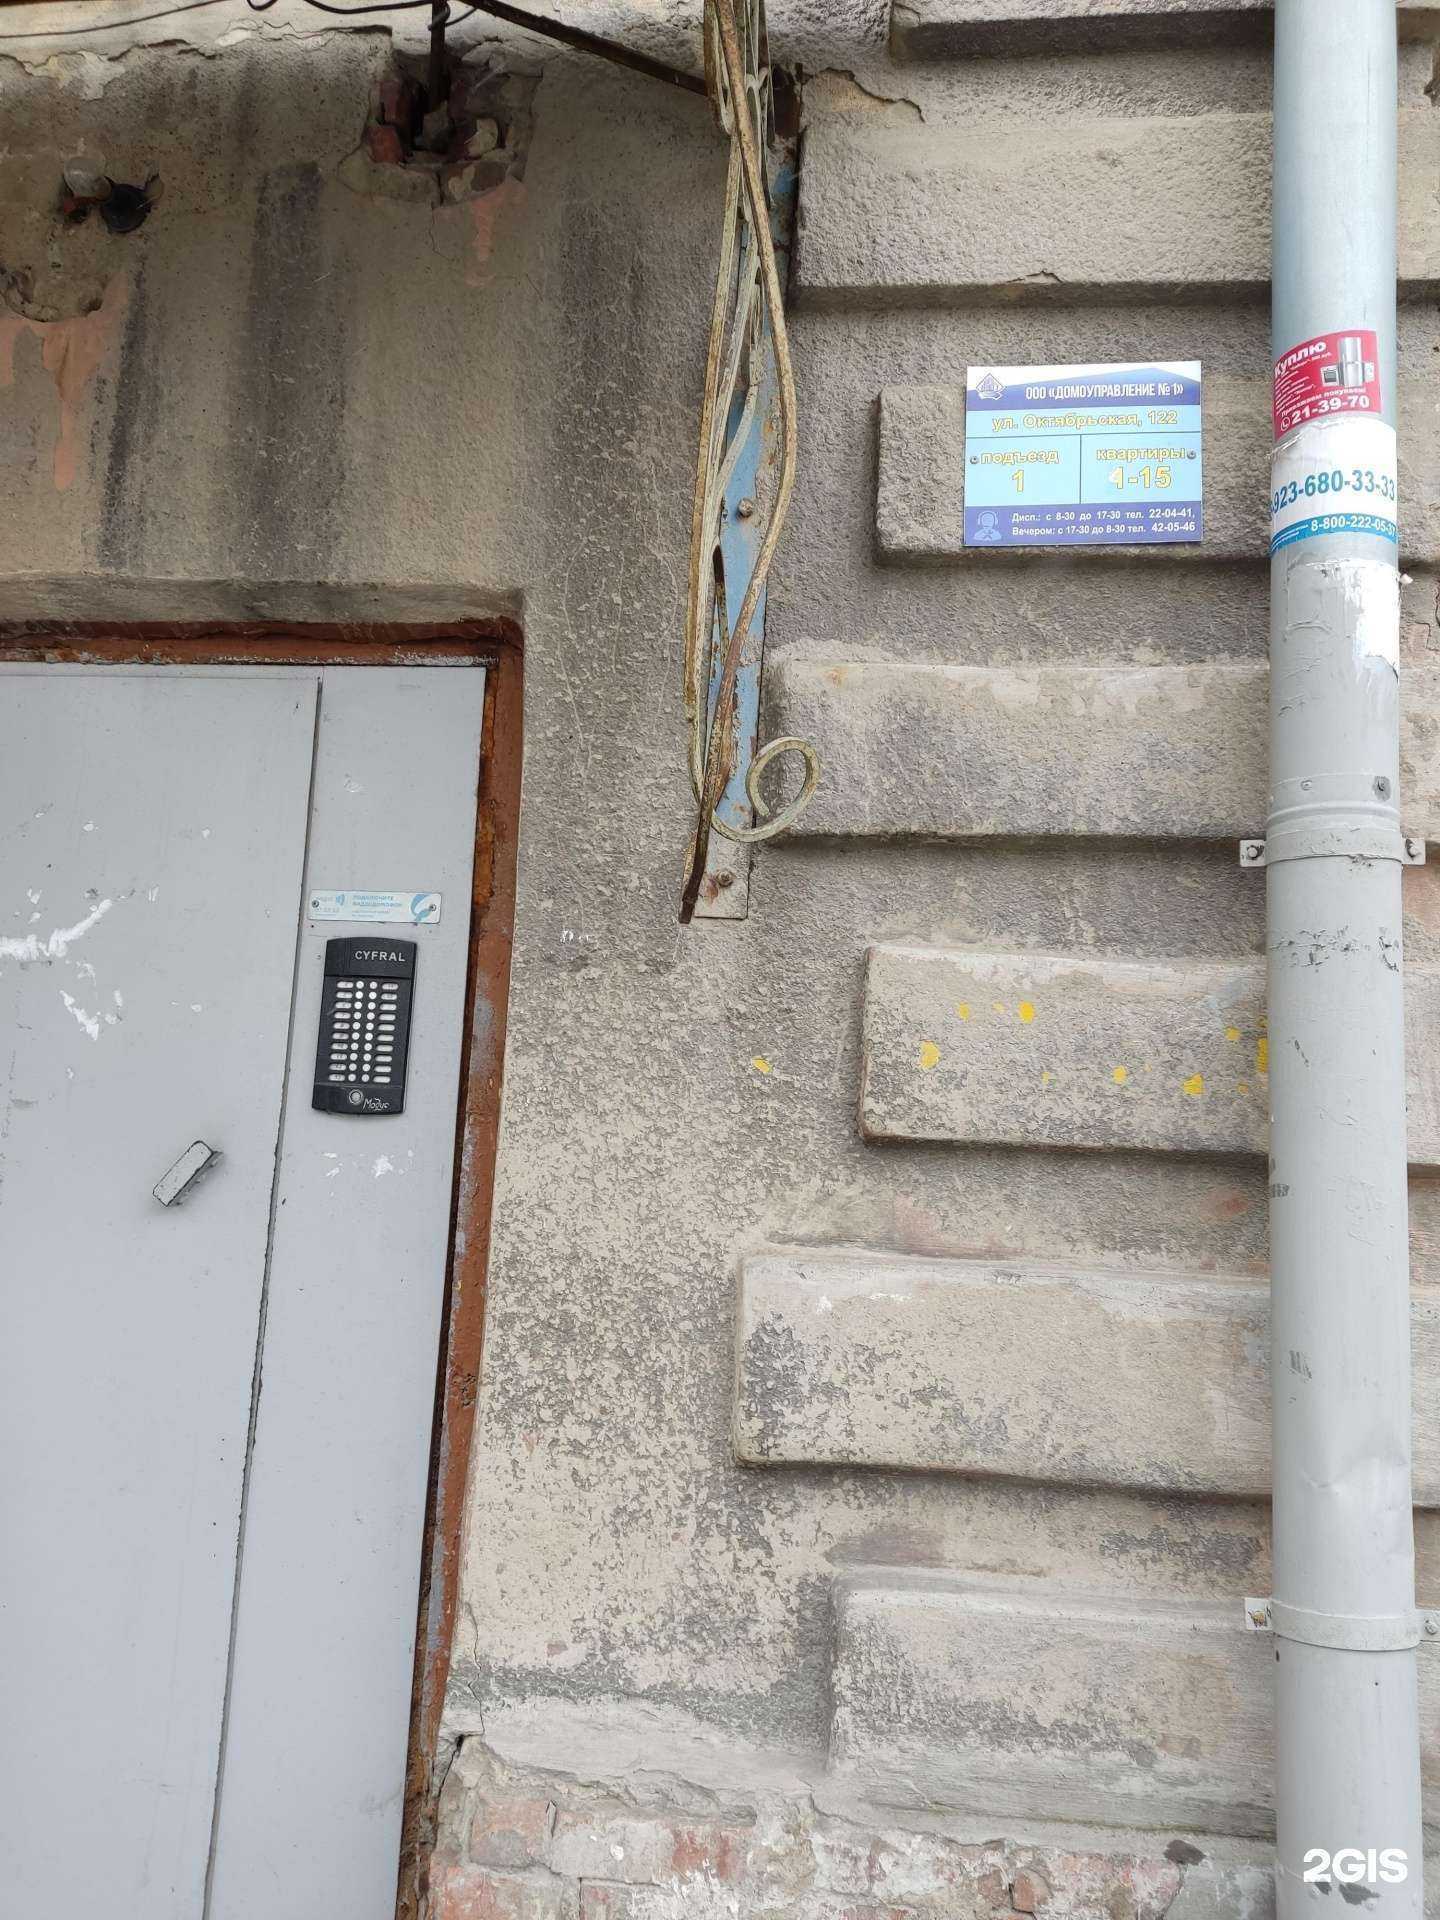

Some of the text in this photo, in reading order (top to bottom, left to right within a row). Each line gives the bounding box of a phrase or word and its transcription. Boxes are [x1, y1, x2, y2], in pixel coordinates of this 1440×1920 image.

[1274, 341, 1327, 378] Куплю
[1025, 386, 1047, 400] ООО
[1049, 383, 1156, 400] «ДОМОУПРАВЛЕНИЕ
[1291, 395, 1370, 425] 21-39-70
[992, 410, 1178, 432] ул. Октябрьская, 122
[981, 450, 1059, 465] подъезд
[1096, 447, 1185, 463] квартиры
[1012, 470, 1025, 493] 1
[1109, 465, 1172, 490] 1-15
[1056, 512, 1075, 521] 8-30
[1079, 513, 1092, 522] до
[1097, 511, 1121, 520] 17-30
[1012, 526, 1056, 536] Вечером:
[1065, 525, 1090, 534] 17-30
[1092, 526, 1104, 535] до
[1106, 525, 1125, 534] 8-30
[1151, 521, 1196, 533] 42-05-46
[355, 950, 406, 962] CYFRAL
